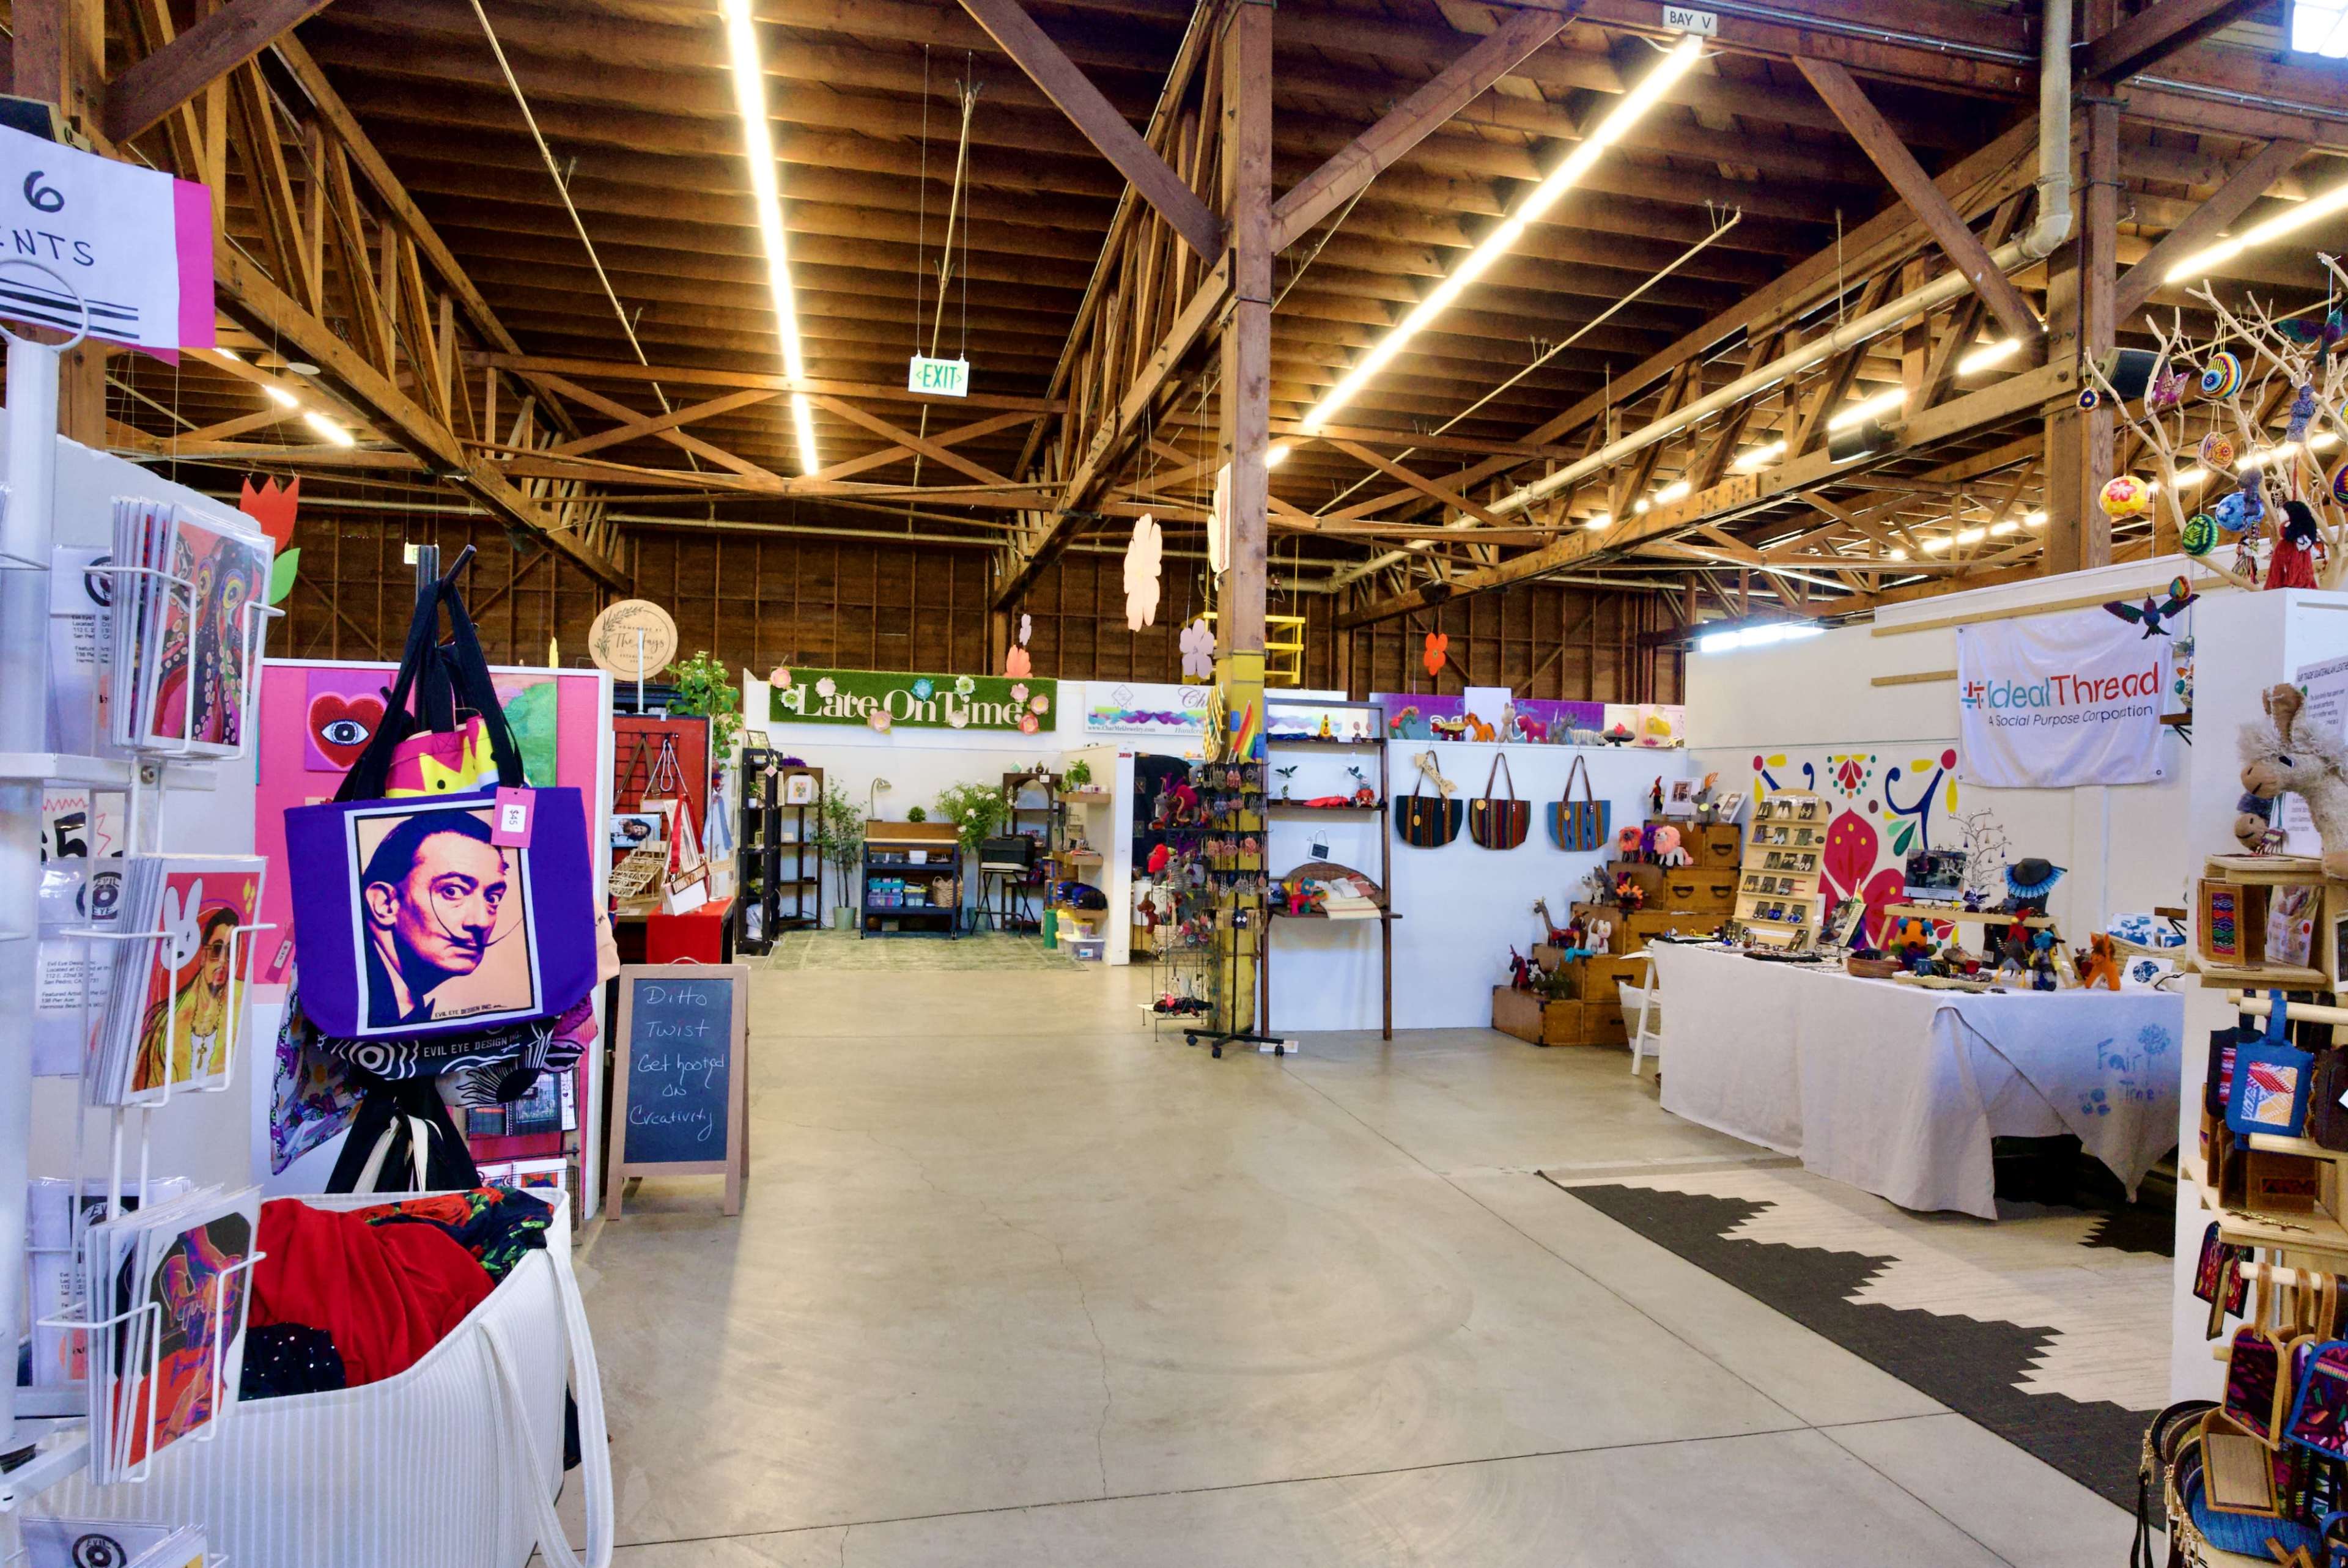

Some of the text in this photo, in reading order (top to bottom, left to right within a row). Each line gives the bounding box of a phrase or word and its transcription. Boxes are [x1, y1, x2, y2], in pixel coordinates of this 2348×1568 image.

[1670, 11, 1711, 29] BAY V
[23, 171, 65, 213] 6
[923, 364, 958, 390] EXIT
[611, 632, 632, 648] The
[796, 683, 1024, 726] Late On Time
[1988, 705, 2153, 727] A Social Purpose Corporation
[509, 809, 519, 825] $45
[643, 986, 707, 1006] Ditto
[460, 1006, 480, 1015] DESIGN
[646, 1018, 711, 1037] Twist
[424, 1046, 448, 1058] EVIL
[451, 1043, 470, 1054] EYE
[474, 1036, 508, 1050] DESIGN
[2098, 1038, 2142, 1073] Fair
[638, 1054, 673, 1073] Get
[630, 1105, 714, 1141] Creativity
